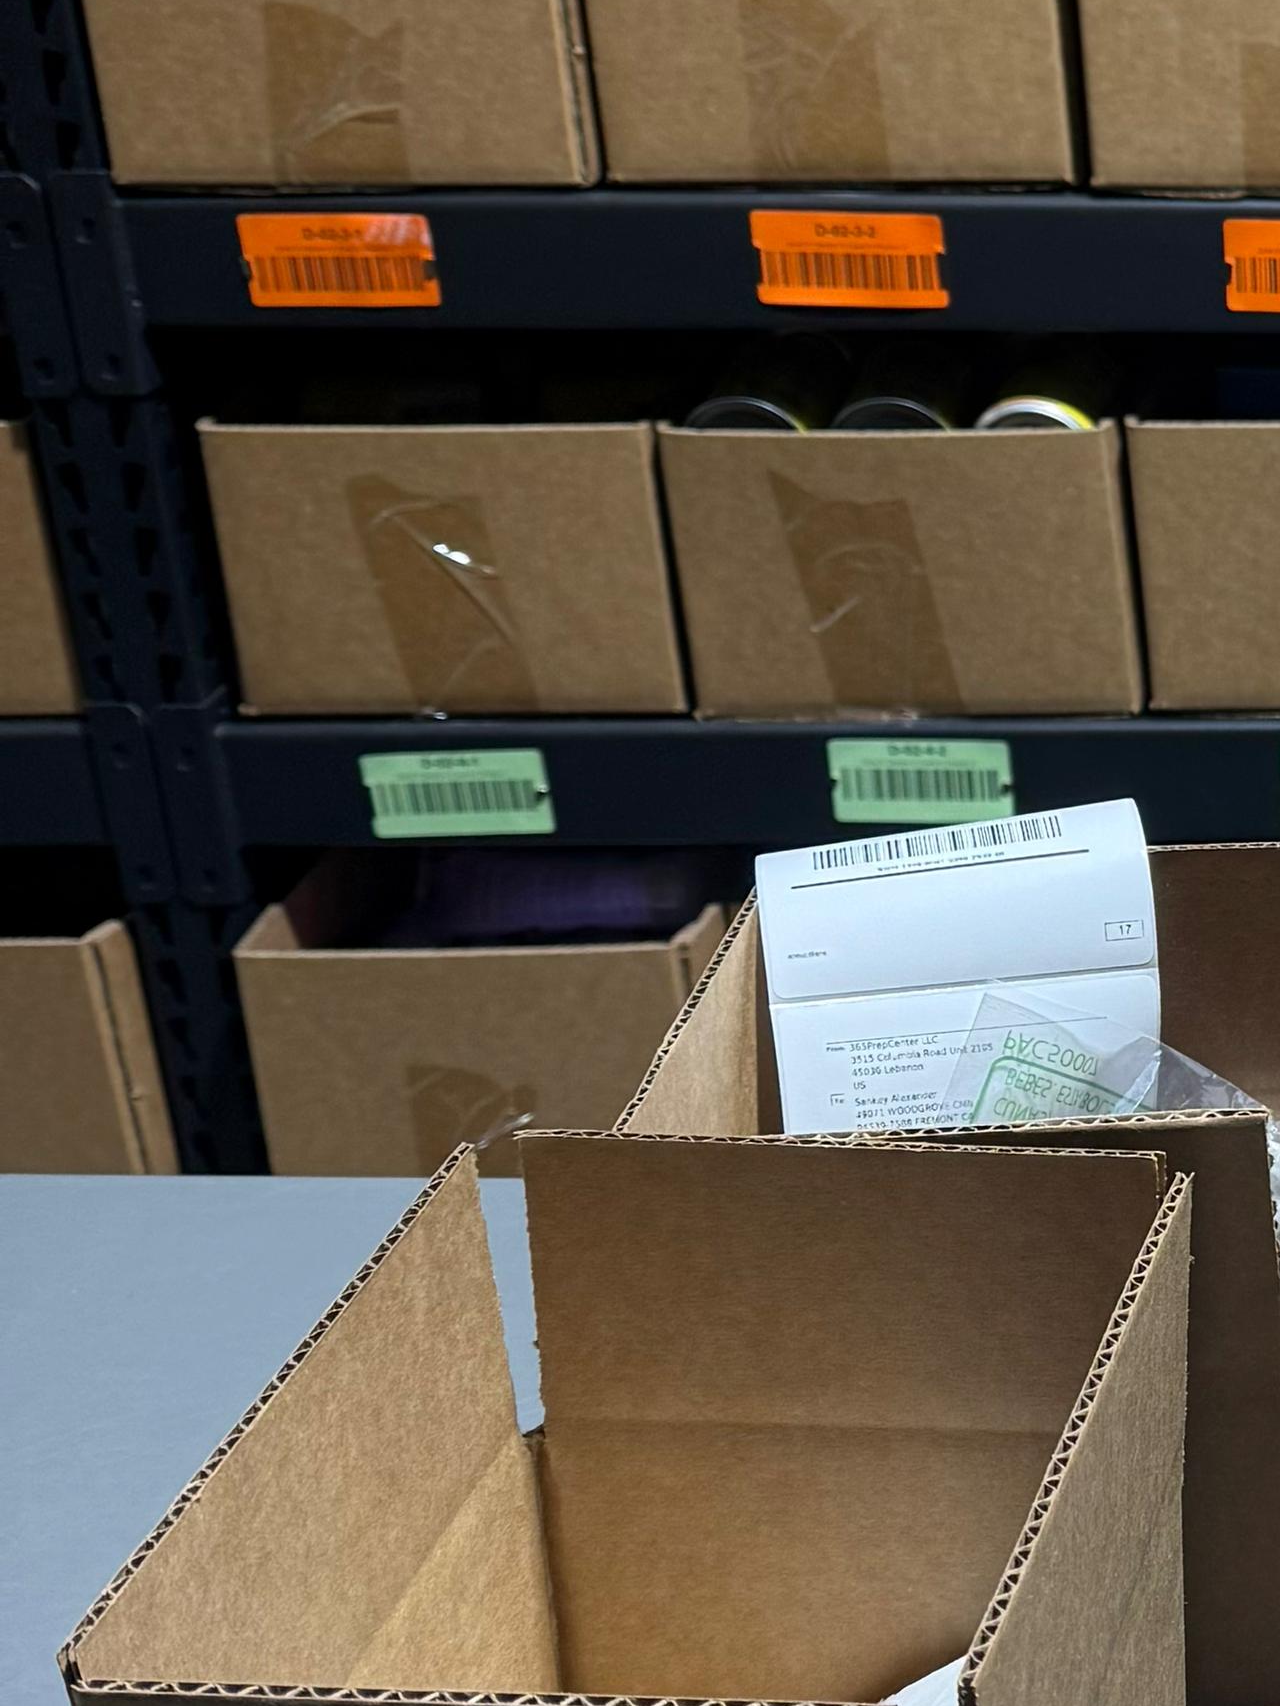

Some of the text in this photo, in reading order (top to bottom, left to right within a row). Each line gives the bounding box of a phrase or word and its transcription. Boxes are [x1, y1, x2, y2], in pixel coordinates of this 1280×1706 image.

[1120, 924, 1131, 936] 17
[923, 1047, 947, 1058] Road
[853, 1081, 866, 1090] US
